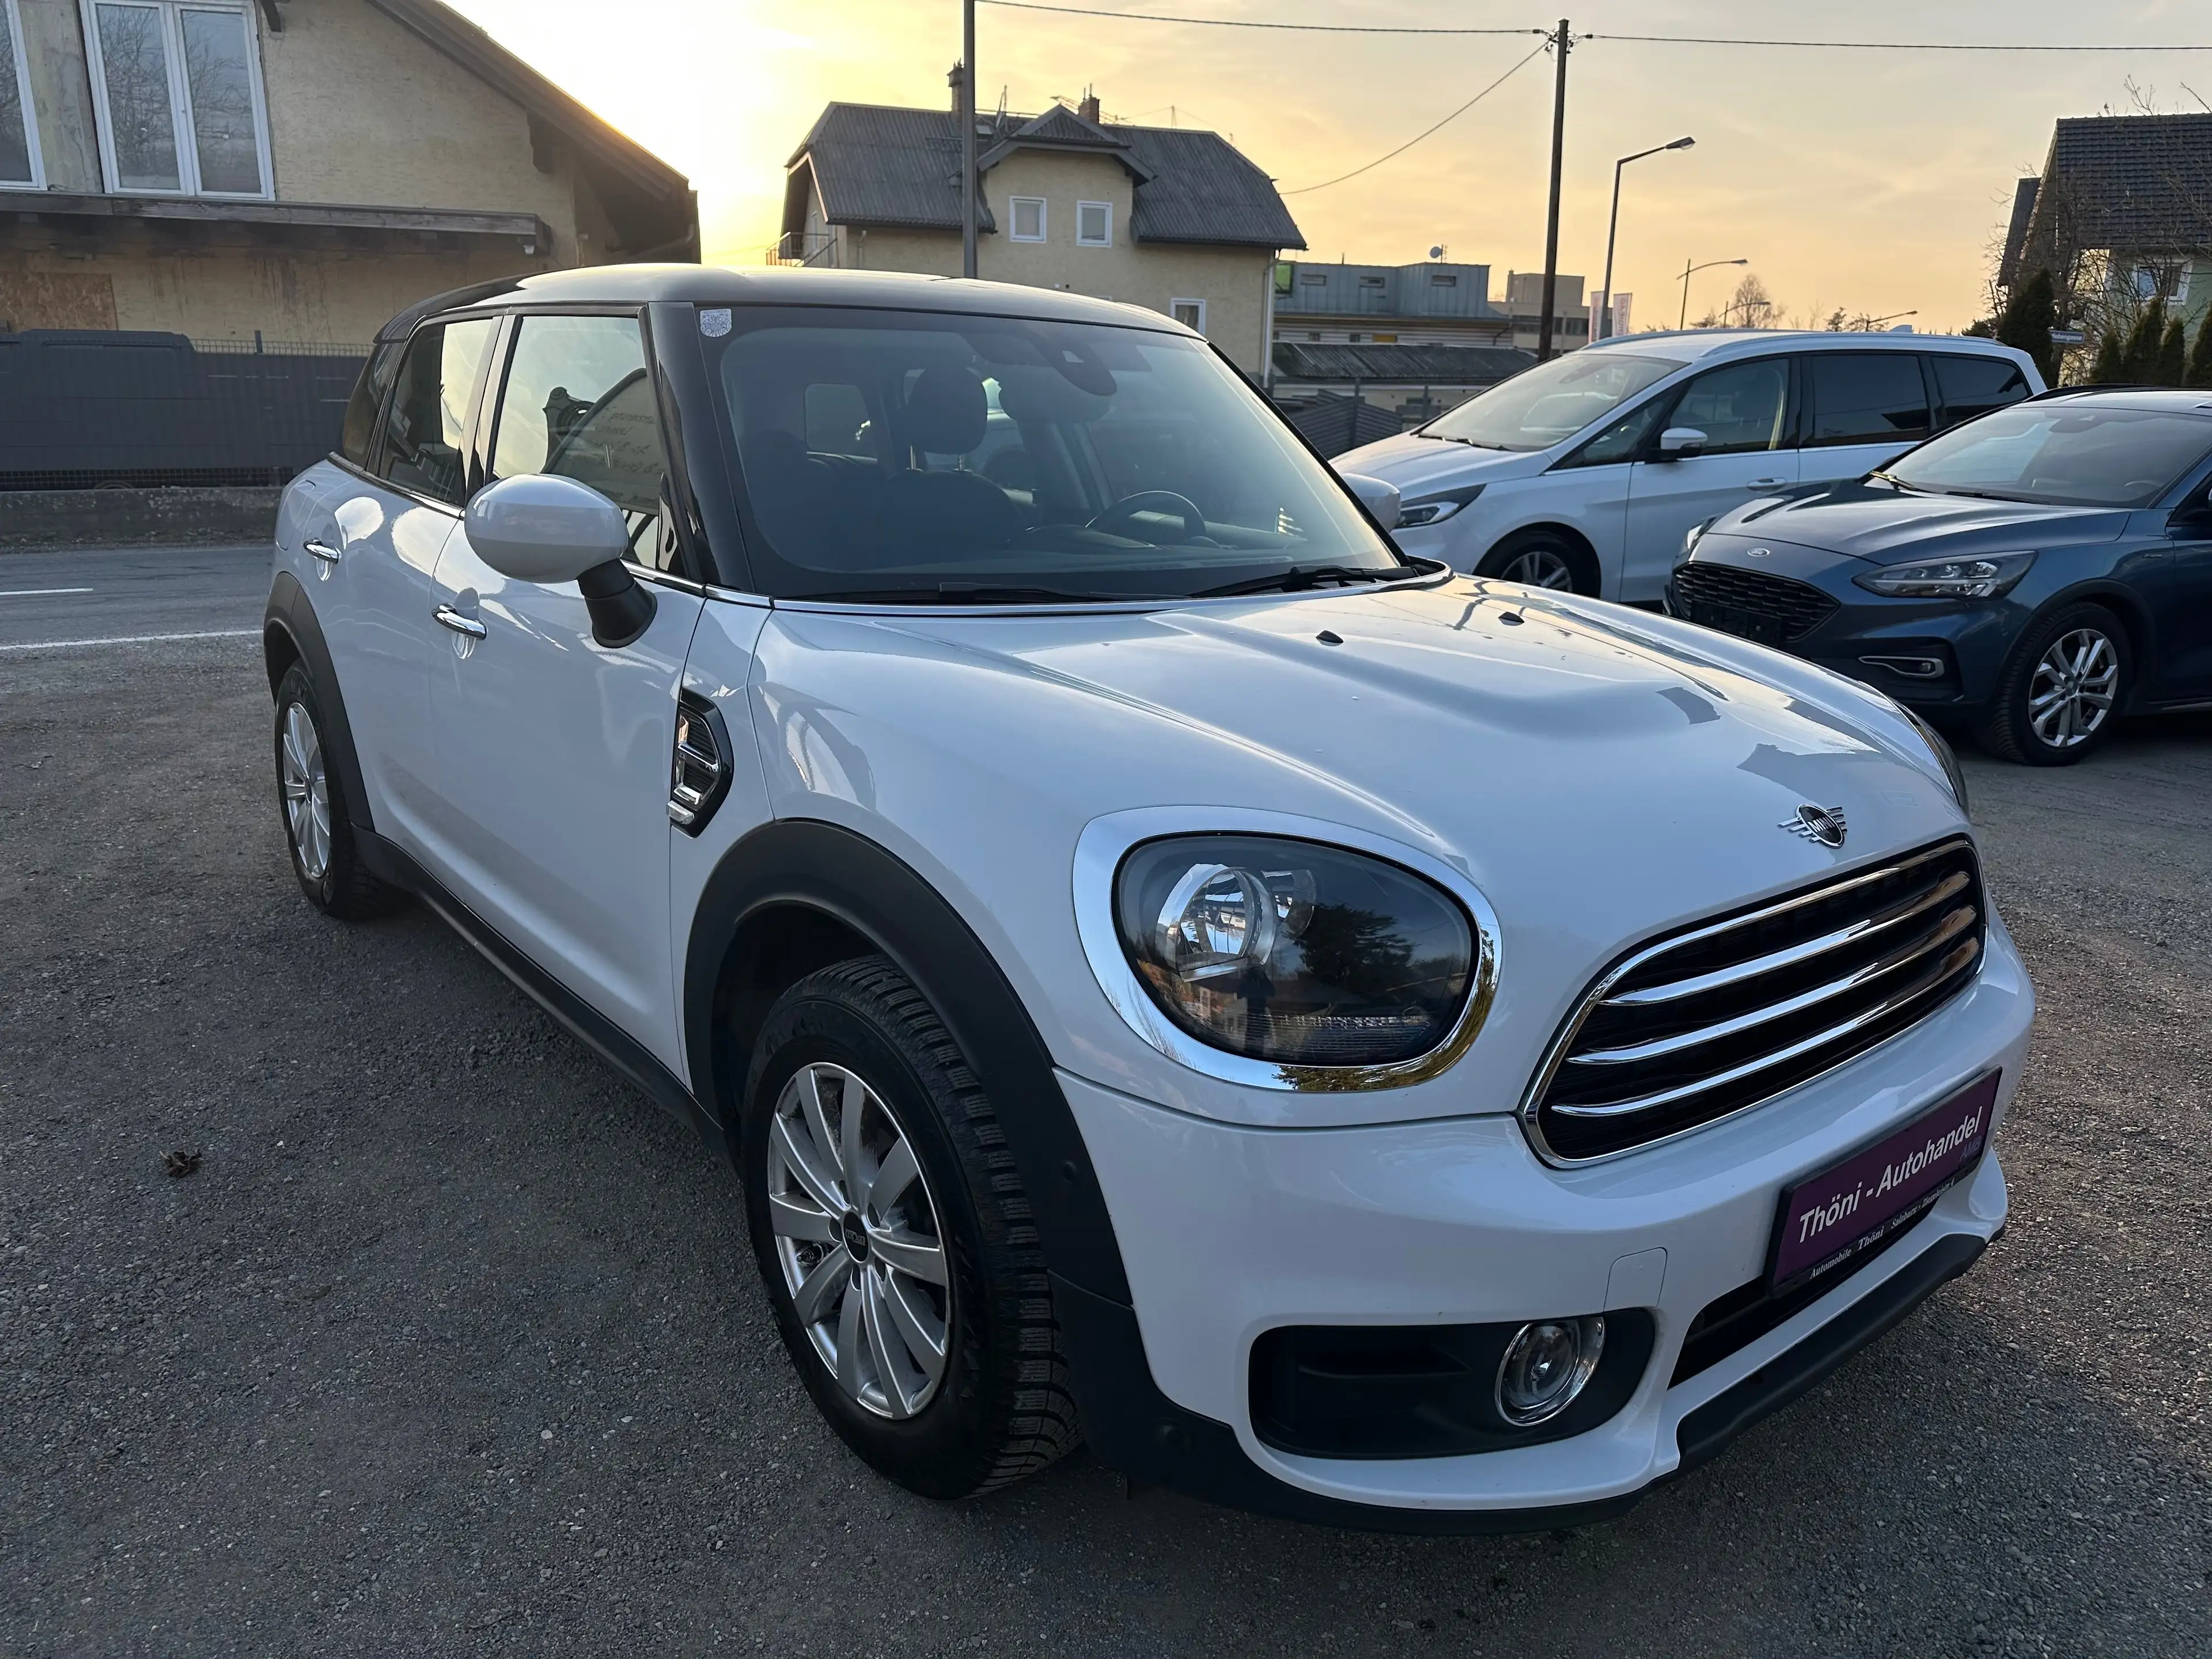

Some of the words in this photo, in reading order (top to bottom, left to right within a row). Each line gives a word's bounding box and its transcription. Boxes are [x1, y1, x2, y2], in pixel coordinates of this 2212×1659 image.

[1808, 816, 1835, 832] MINI
[1798, 1181, 1863, 1244] Thöni
[1875, 1105, 1983, 1198] Autohandel
[1809, 1248, 1851, 1280] Automobile
[1857, 1225, 1885, 1251] Thöni
